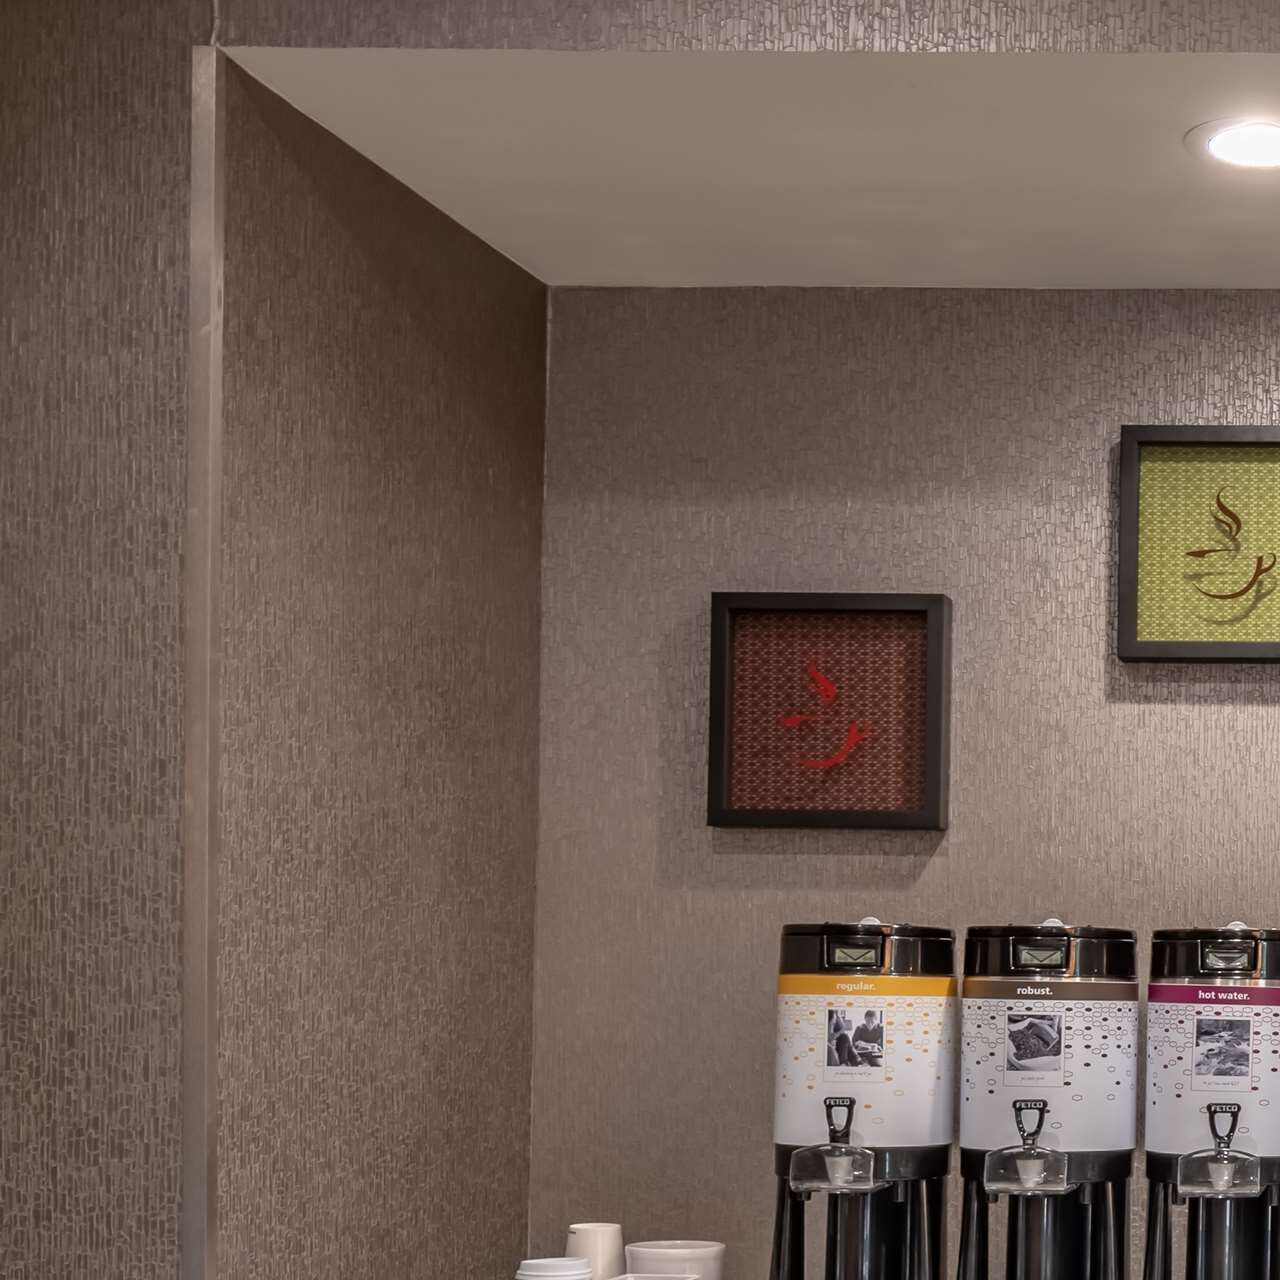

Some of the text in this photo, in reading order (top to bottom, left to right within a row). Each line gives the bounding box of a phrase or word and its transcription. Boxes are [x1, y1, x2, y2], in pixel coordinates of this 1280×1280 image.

[836, 981, 877, 992] regular.
[1017, 986, 1053, 995] robust.
[1198, 990, 1250, 1000] hot water.
